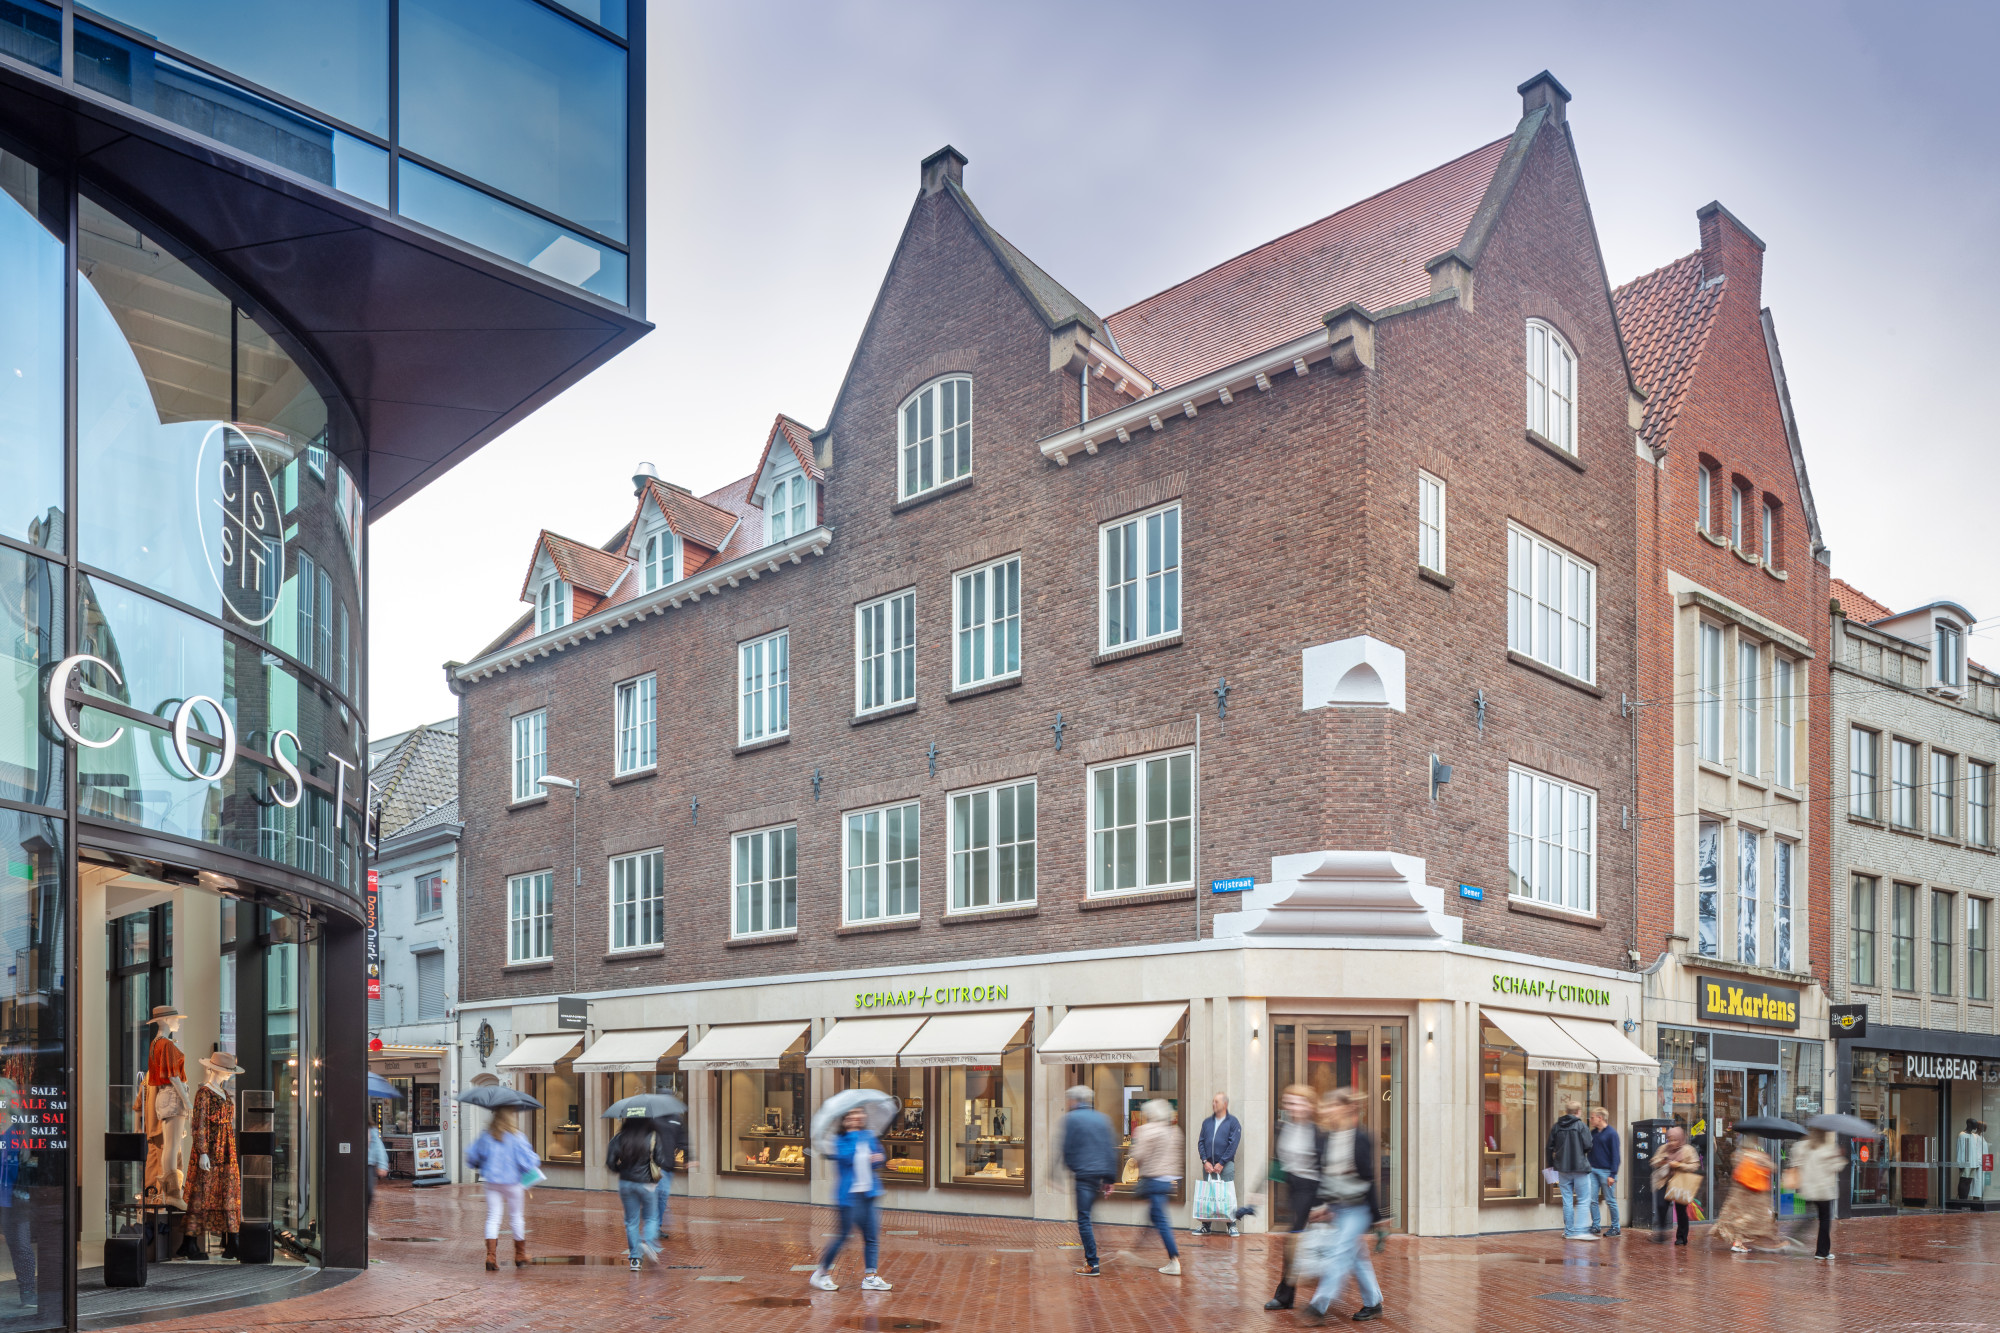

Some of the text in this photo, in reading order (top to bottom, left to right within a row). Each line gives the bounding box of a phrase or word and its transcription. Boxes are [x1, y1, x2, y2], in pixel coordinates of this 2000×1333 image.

[1214, 880, 1252, 890] Vrijstraat
[1464, 888, 1480, 897] Demer
[1907, 1056, 1977, 1080] PULL&BEAR
[31, 1087, 58, 1095] SALE
[11, 1099, 47, 1109] SALE
[11, 1115, 38, 1123] SALE
[31, 1127, 58, 1135] SALE
[11, 1139, 47, 1149] SALE
